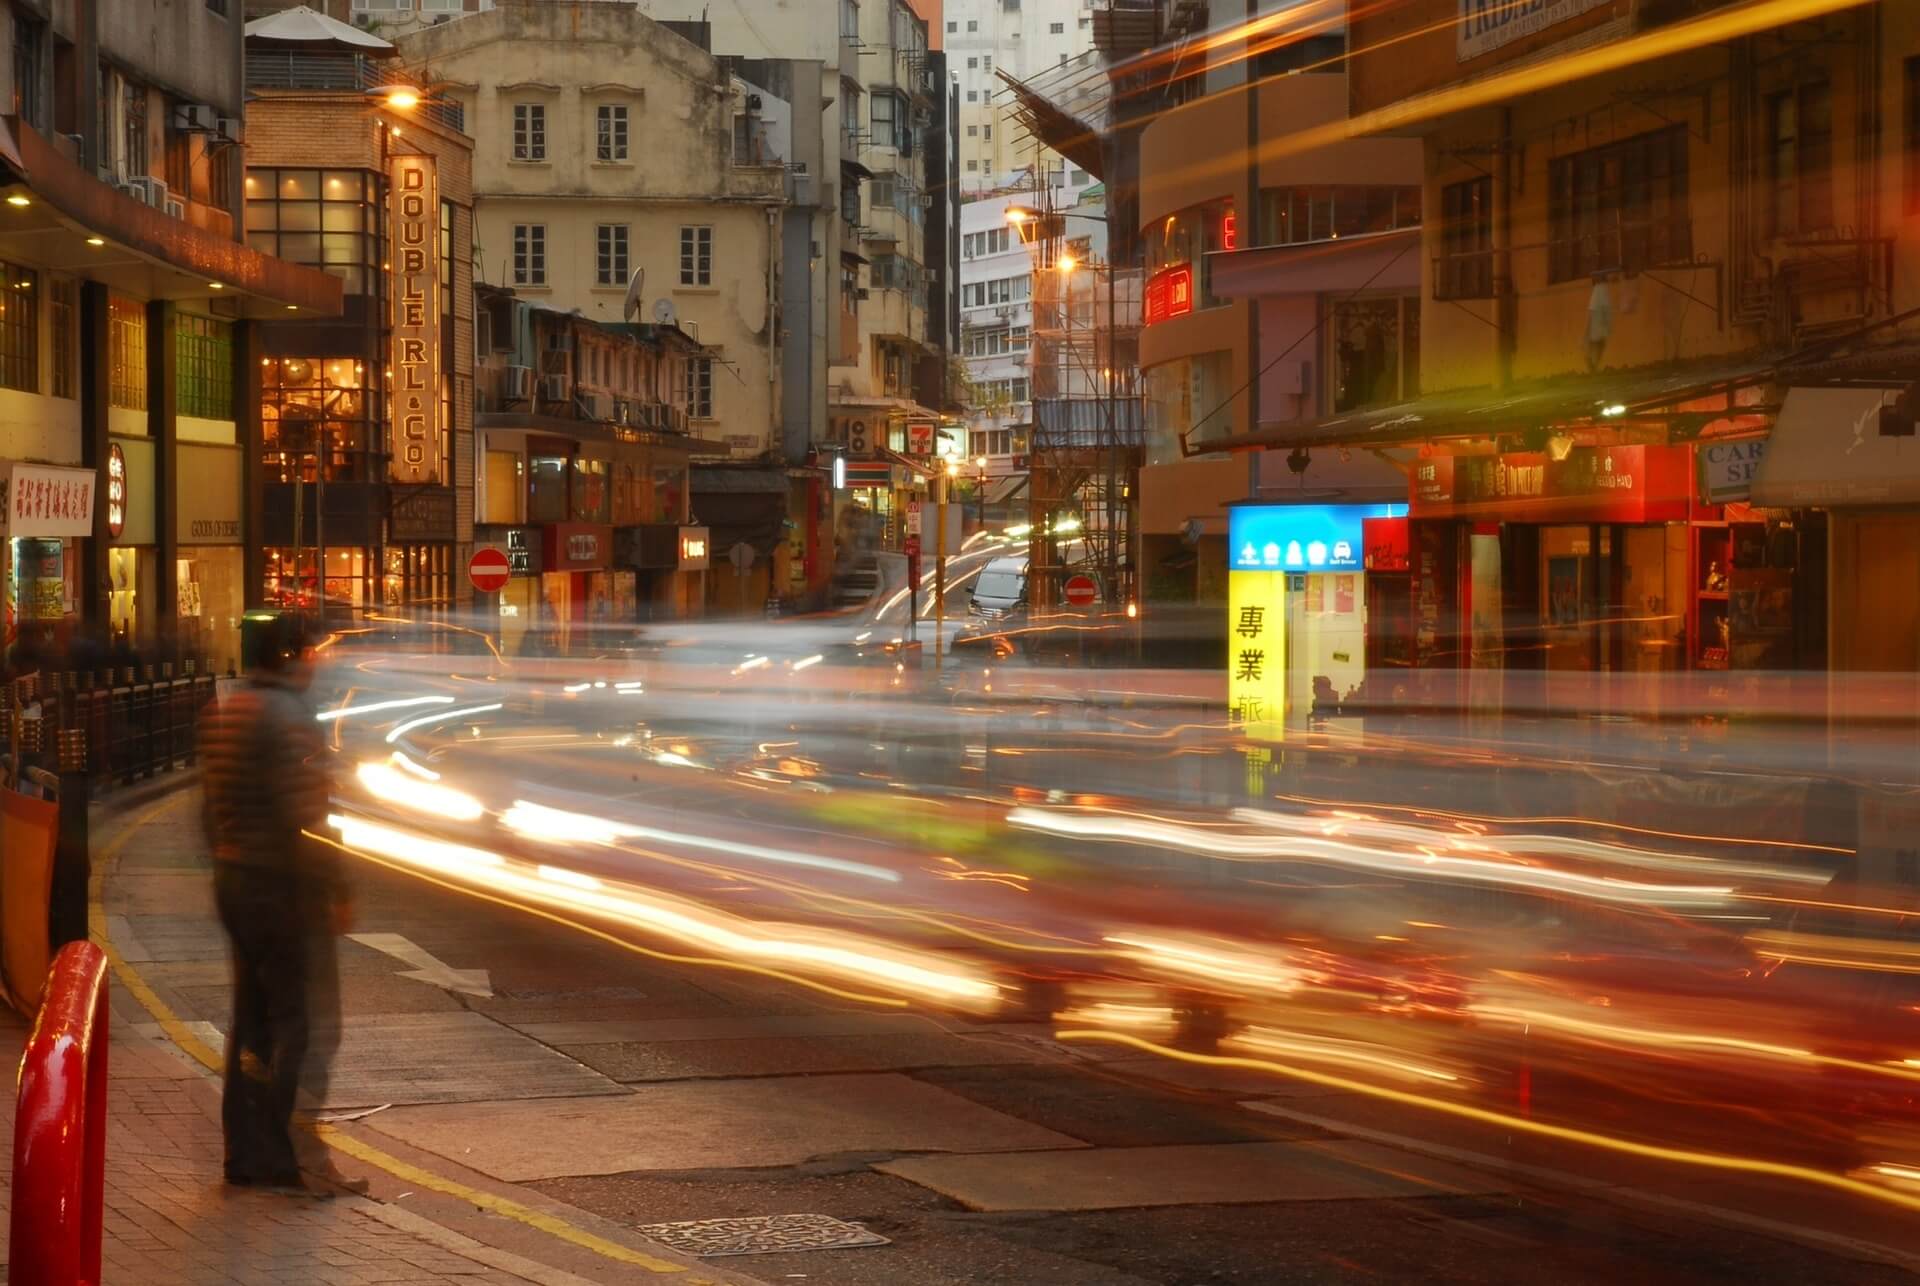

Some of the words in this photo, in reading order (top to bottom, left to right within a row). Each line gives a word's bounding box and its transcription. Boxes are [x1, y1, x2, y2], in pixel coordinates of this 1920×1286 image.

[400, 168, 426, 327] DOUBLE
[400, 338, 428, 390] RL
[407, 396, 422, 411] &
